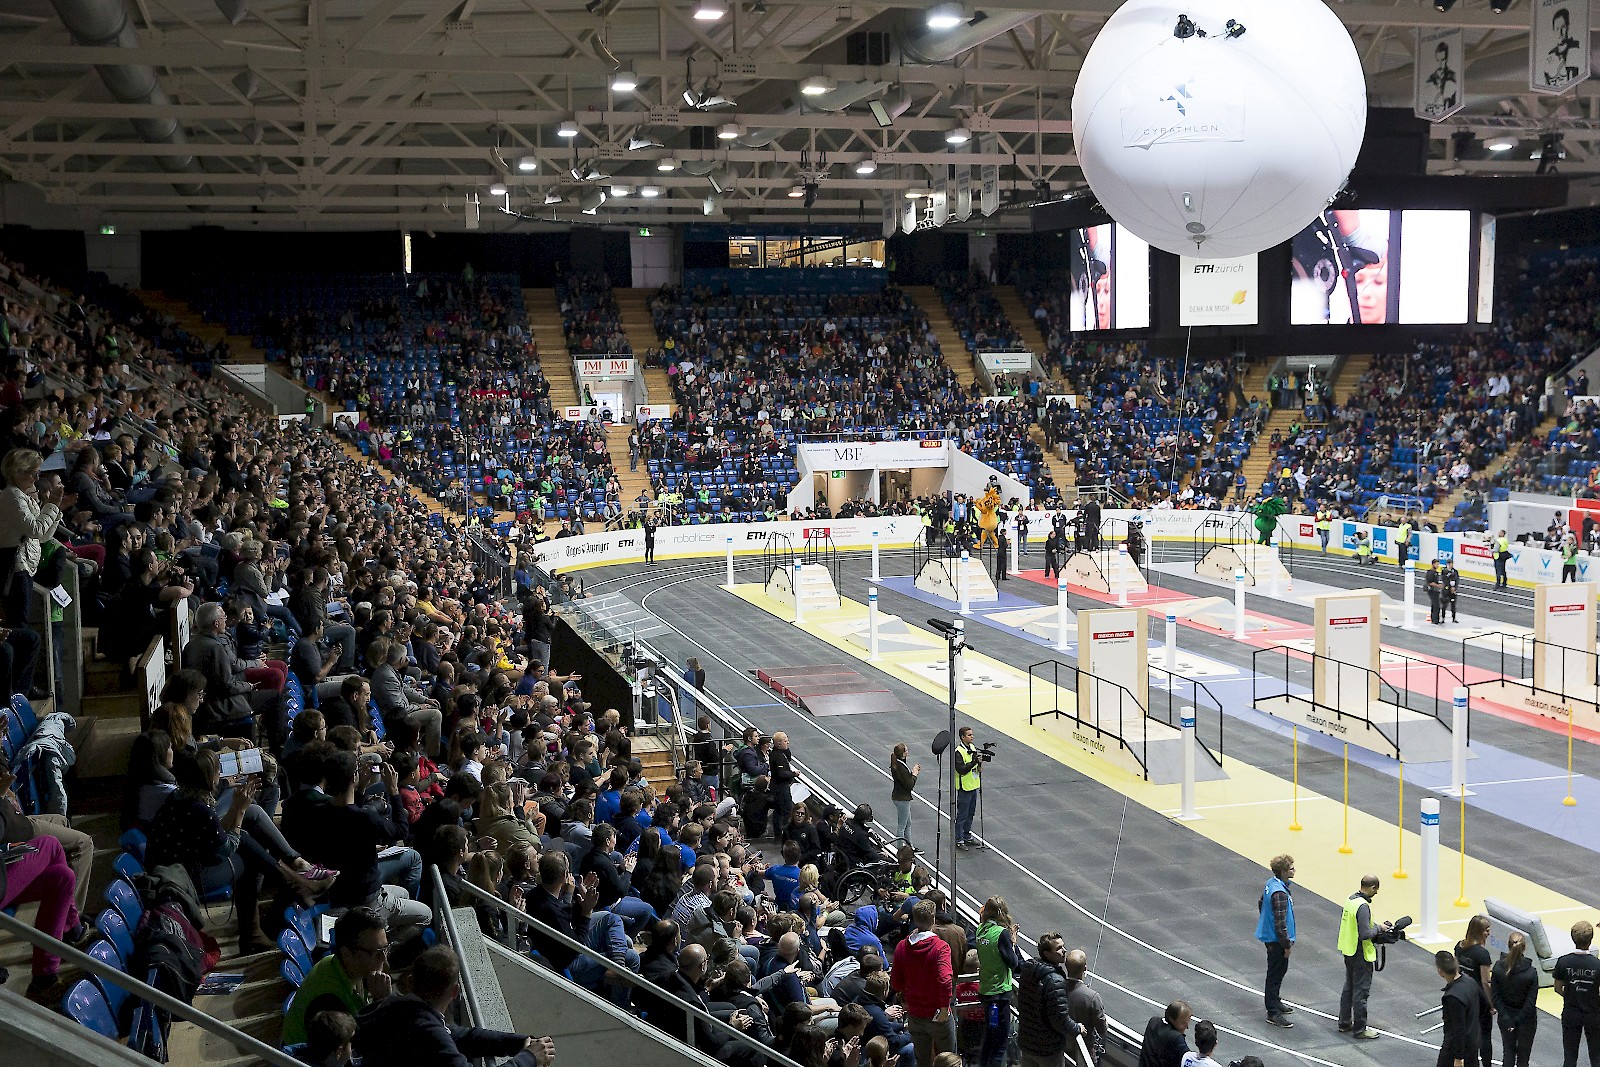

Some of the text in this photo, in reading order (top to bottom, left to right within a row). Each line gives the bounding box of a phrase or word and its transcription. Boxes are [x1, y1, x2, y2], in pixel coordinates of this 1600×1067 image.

[1193, 264, 1215, 274] ETH
[834, 447, 863, 461] MBF
[1204, 520, 1224, 530] ETH
[673, 533, 712, 544] robotics
[747, 531, 767, 541] ETH
[618, 538, 635, 548] ETH
[1524, 697, 1570, 717] maxon moto
[1306, 713, 1348, 735] maxon motor
[1072, 731, 1106, 753] maxon motor
